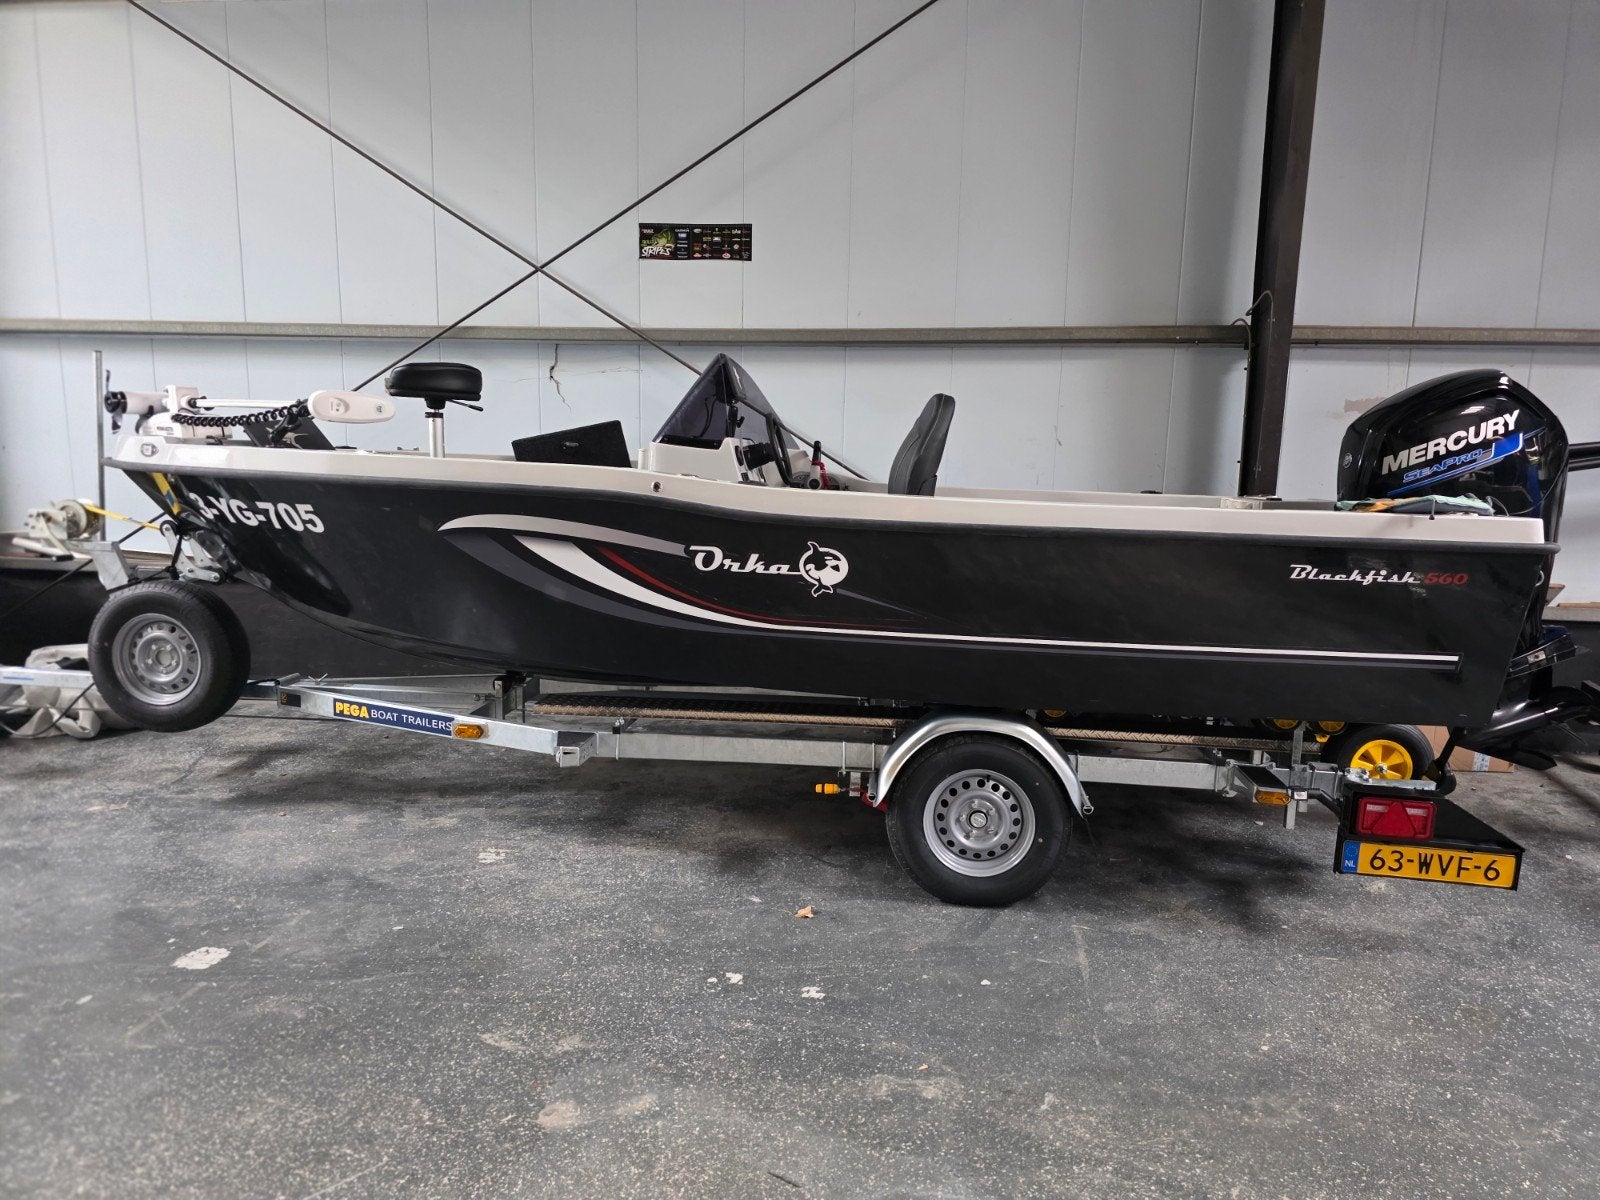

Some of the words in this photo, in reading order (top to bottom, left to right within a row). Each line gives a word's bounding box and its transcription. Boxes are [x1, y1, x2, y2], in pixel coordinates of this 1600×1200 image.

[1381, 409, 1520, 475] MERCURY
[1402, 448, 1484, 483] SEAPRO
[689, 545, 792, 575] Orka
[1290, 564, 1420, 585] Blackfish
[1424, 572, 1469, 585] 560
[335, 701, 369, 719] PEGA
[371, 709, 398, 722] BOAT
[401, 714, 453, 731] TRAILERS
[1344, 859, 1356, 868] NL
[1369, 849, 1501, 882] 63-WVF-6
